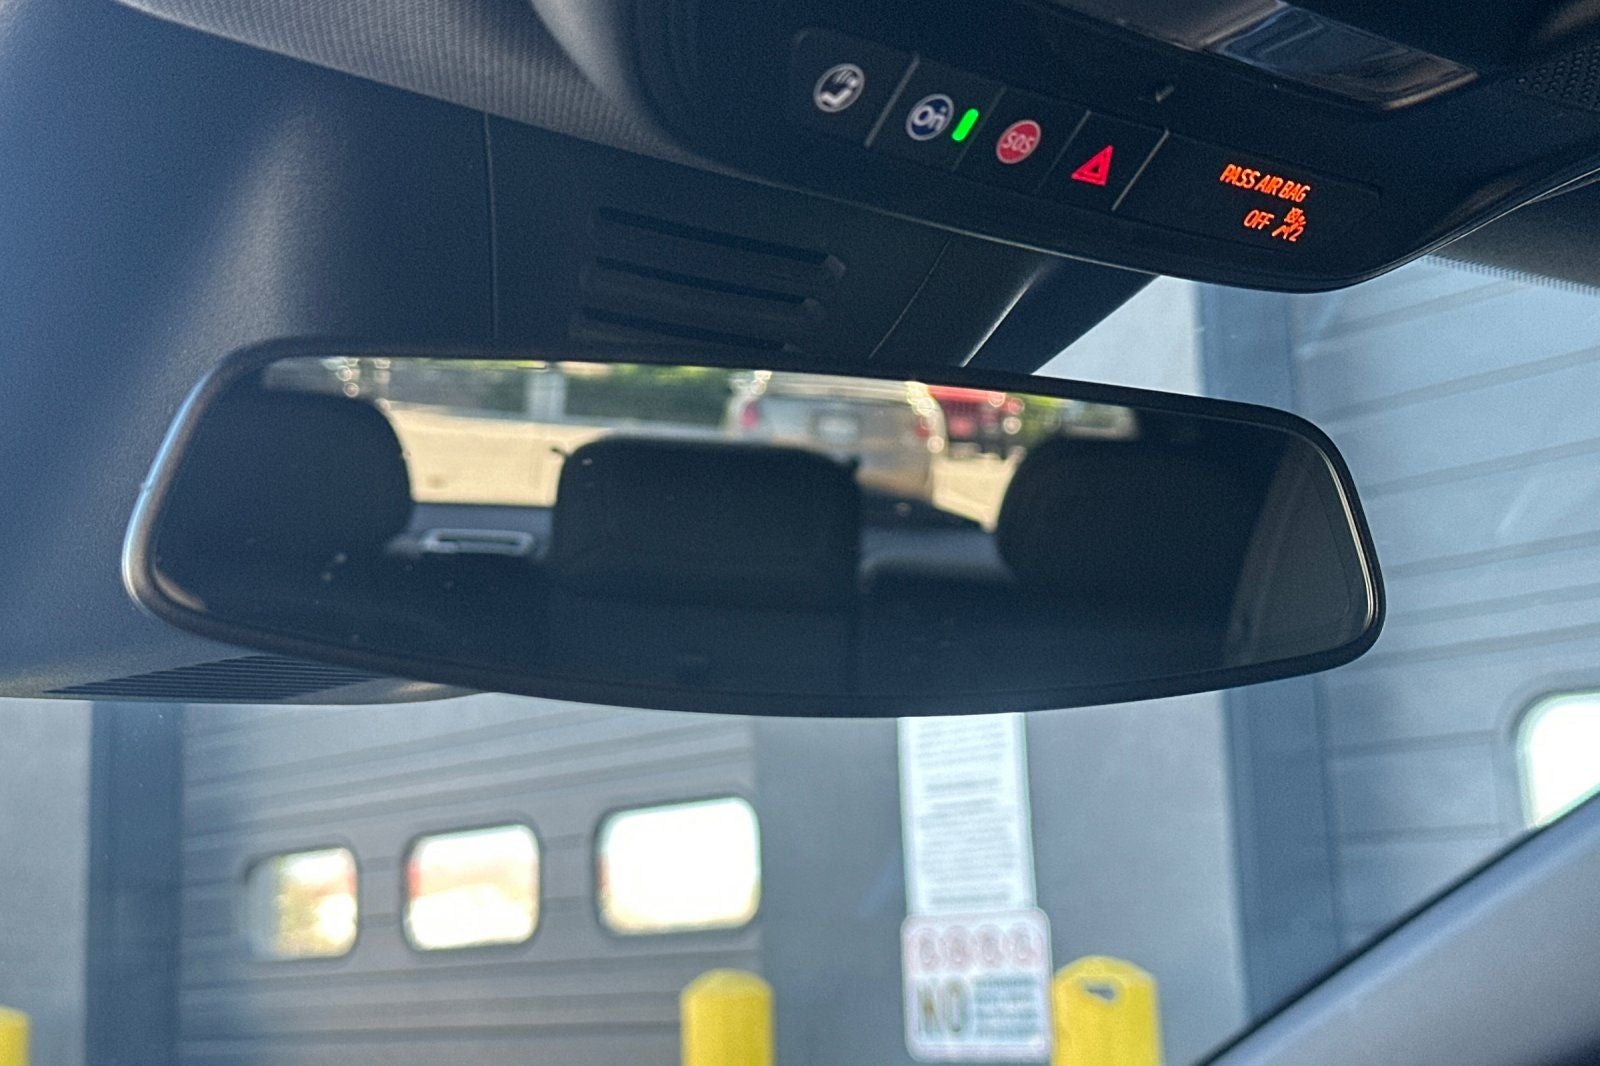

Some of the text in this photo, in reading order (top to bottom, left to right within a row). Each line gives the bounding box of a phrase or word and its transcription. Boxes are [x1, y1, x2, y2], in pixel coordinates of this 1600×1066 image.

[1002, 131, 1036, 154] SOS
[1220, 164, 1311, 203] PASS AIR BAG
[1243, 209, 1275, 230] OFF
